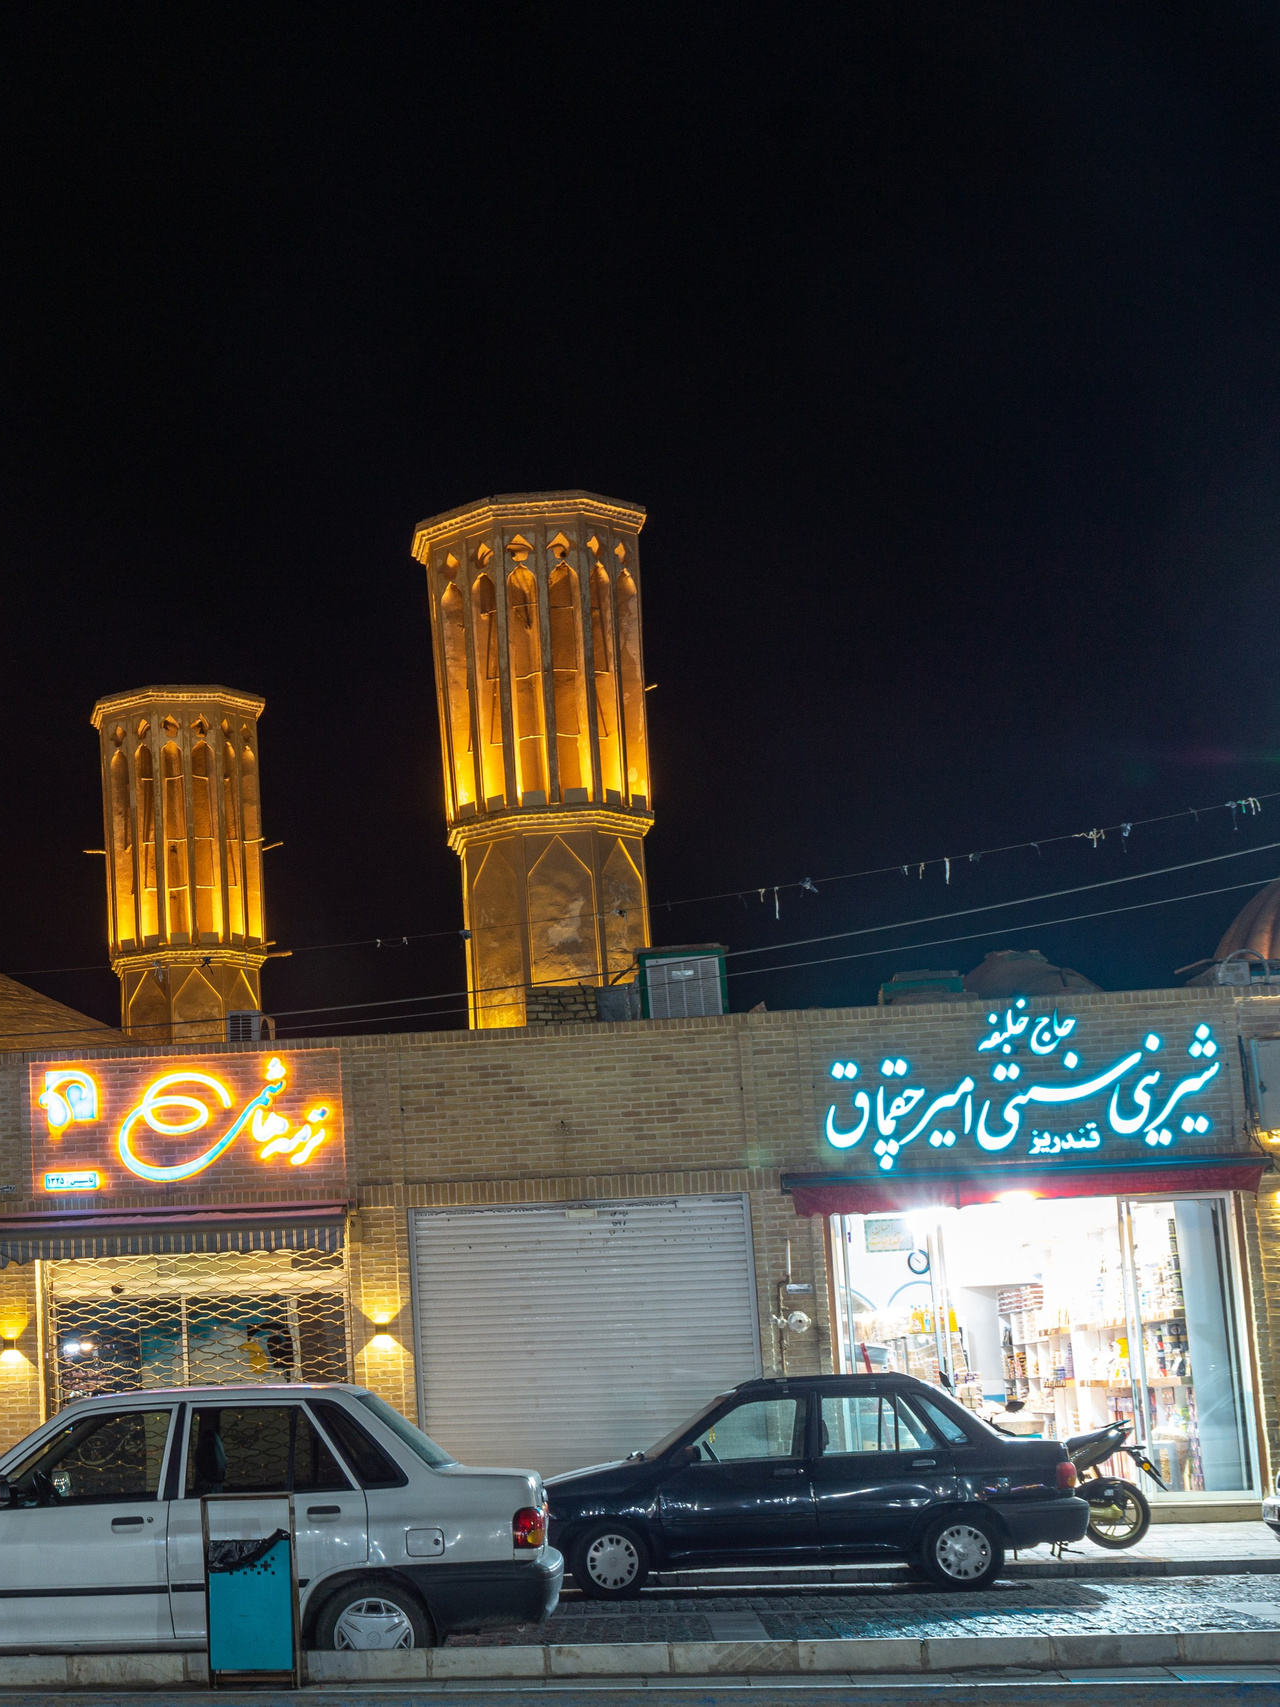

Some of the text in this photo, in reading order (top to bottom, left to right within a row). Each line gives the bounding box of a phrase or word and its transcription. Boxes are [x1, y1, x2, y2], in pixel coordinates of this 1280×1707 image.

[977, 998, 1076, 1055] حاج خلیفه
[975, 1051, 1142, 1152] سنتی
[1108, 1023, 1221, 1147] شیرینی
[1028, 1122, 1101, 1155] قندریز
